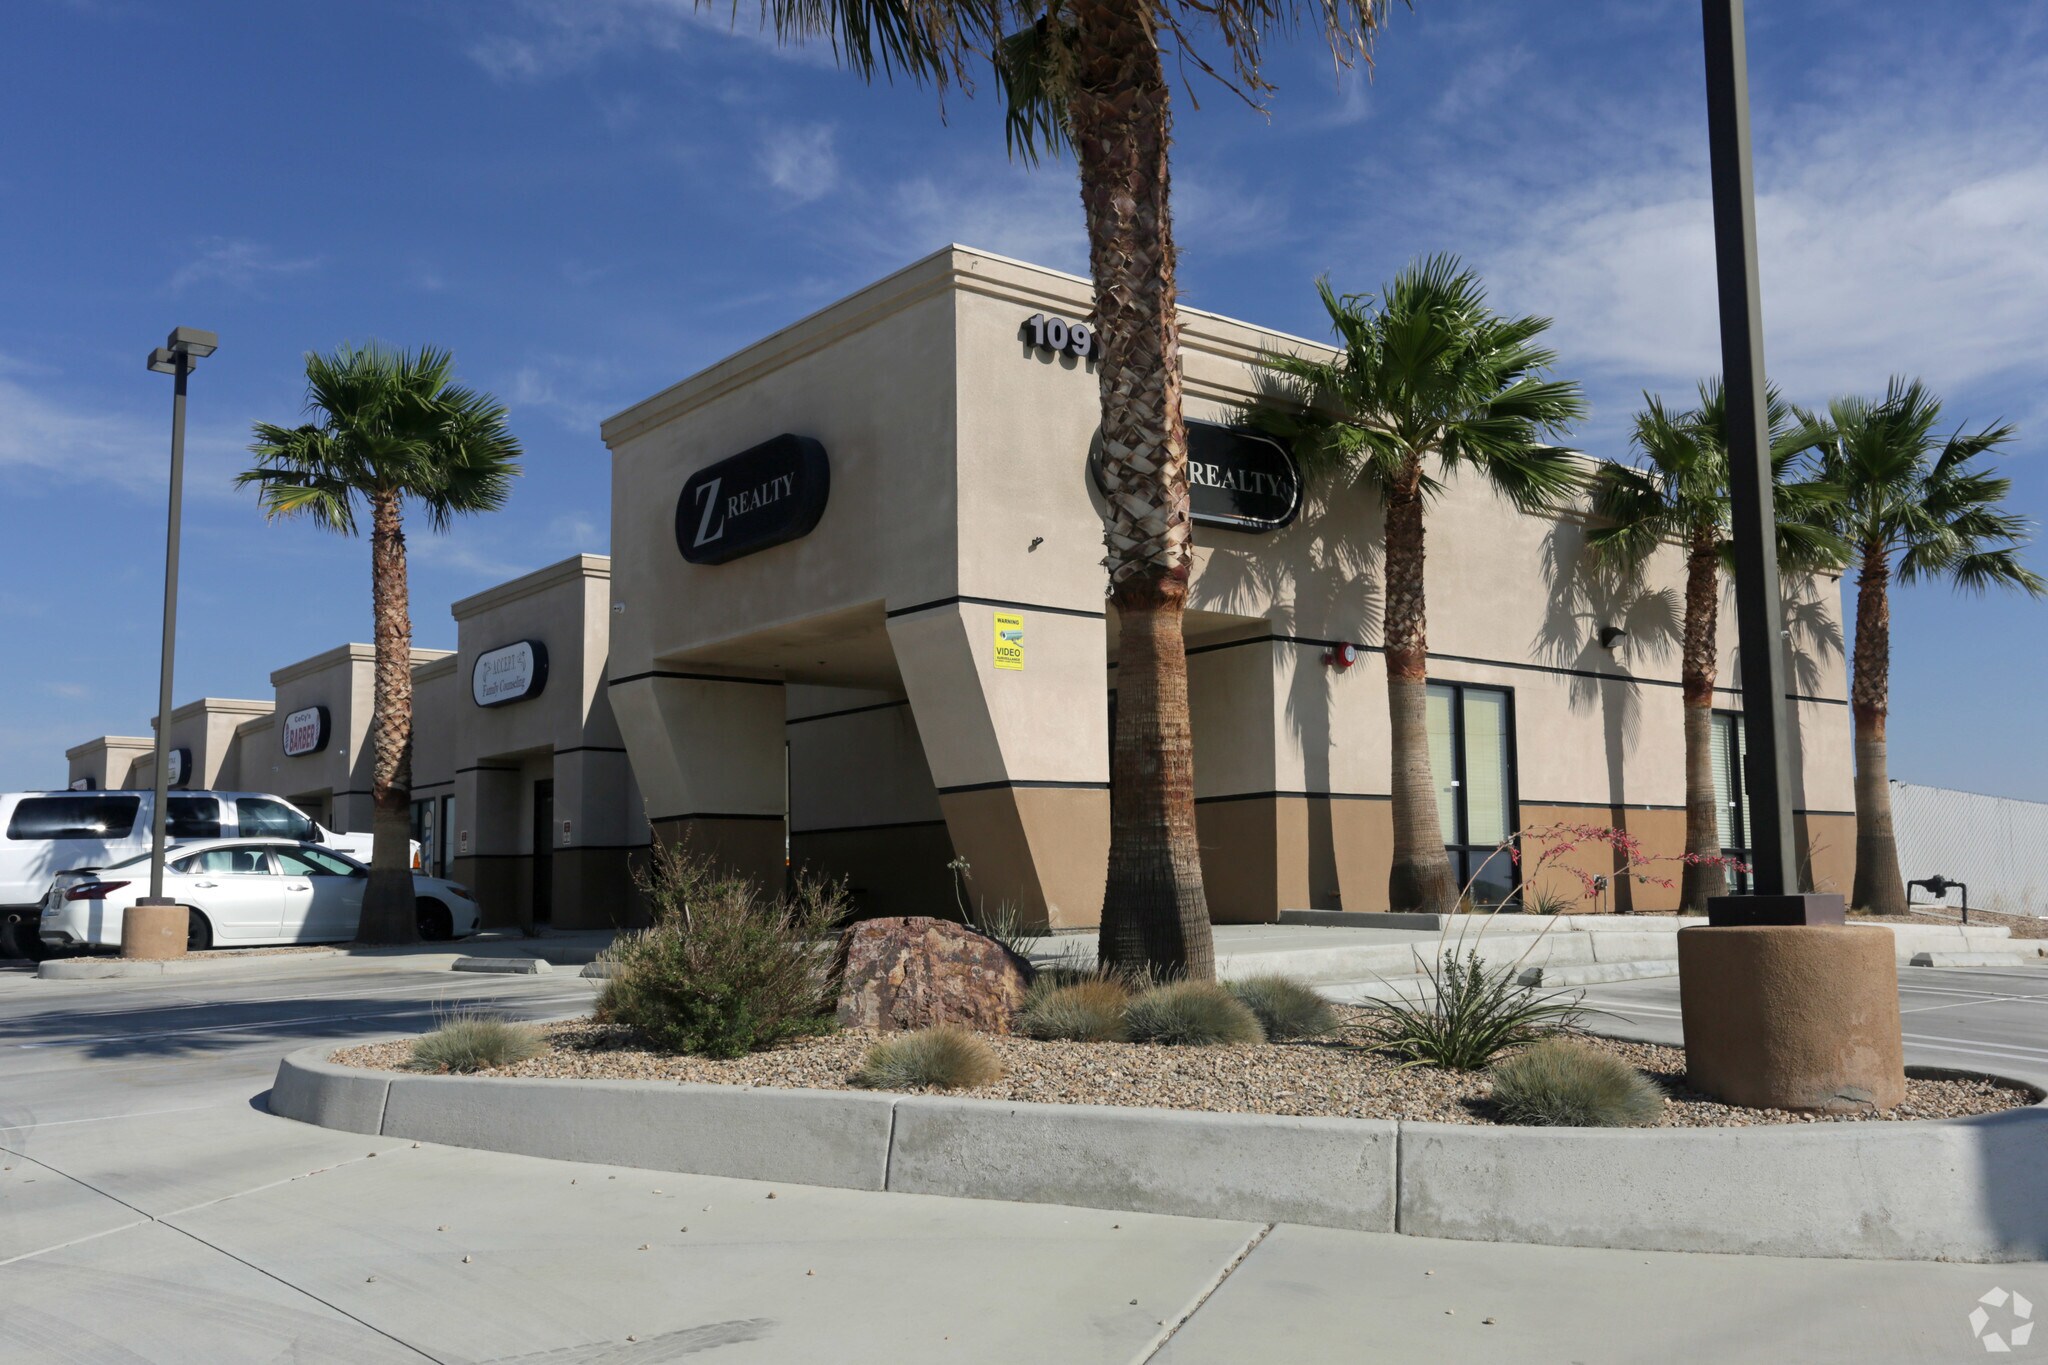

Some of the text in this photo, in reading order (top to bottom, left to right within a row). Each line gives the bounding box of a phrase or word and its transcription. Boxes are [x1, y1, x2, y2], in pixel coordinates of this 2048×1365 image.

[1030, 313, 1095, 358] 109
[1187, 460, 1282, 497] REALTY
[692, 471, 795, 548] Z REALTY
[493, 654, 516, 674] ACCEPT
[996, 647, 1021, 657] VIDEO
[482, 682, 499, 697] Family
[290, 724, 315, 752] BARBER
